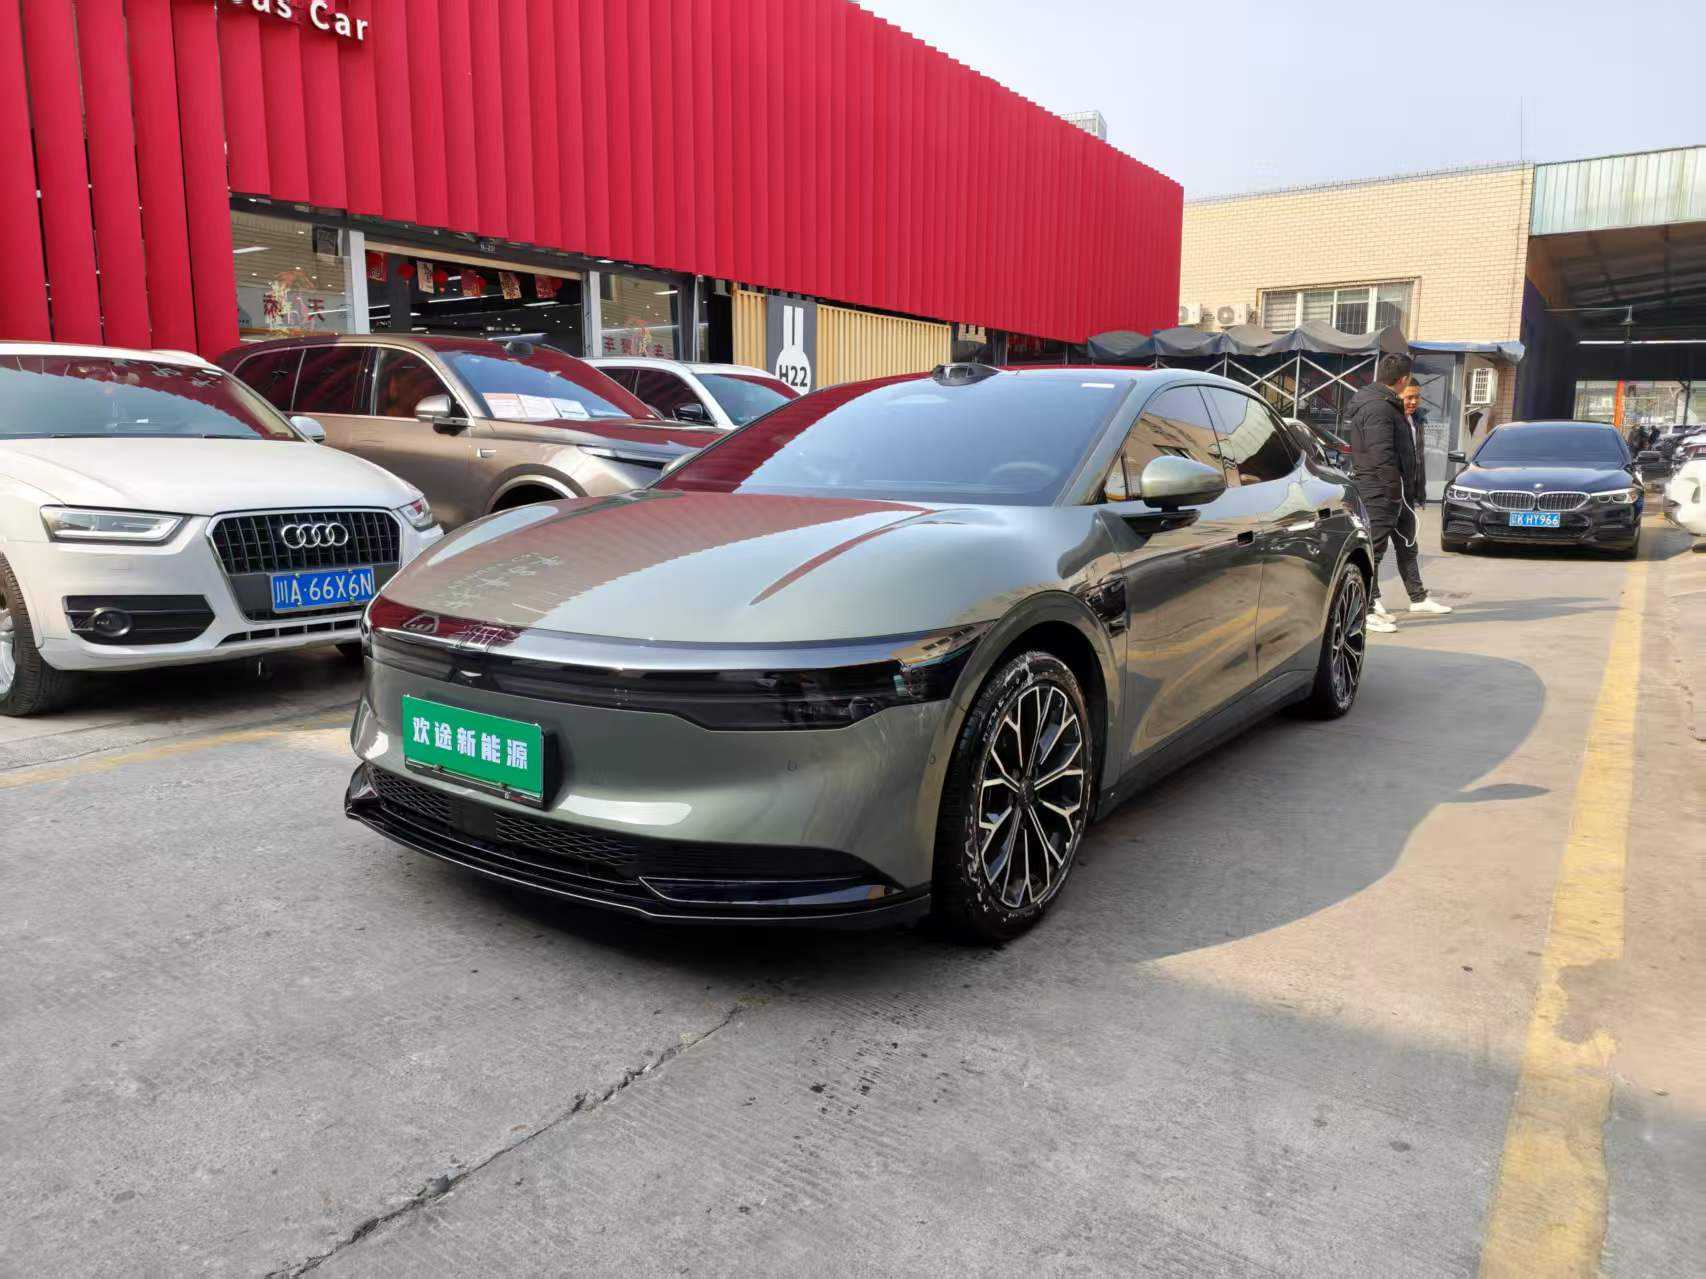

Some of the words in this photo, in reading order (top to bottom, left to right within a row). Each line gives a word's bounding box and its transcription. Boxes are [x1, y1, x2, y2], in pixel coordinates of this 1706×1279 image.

[310, 0, 368, 41] Car
[779, 364, 808, 387] H22
[412, 716, 528, 770] 欢途新能源
